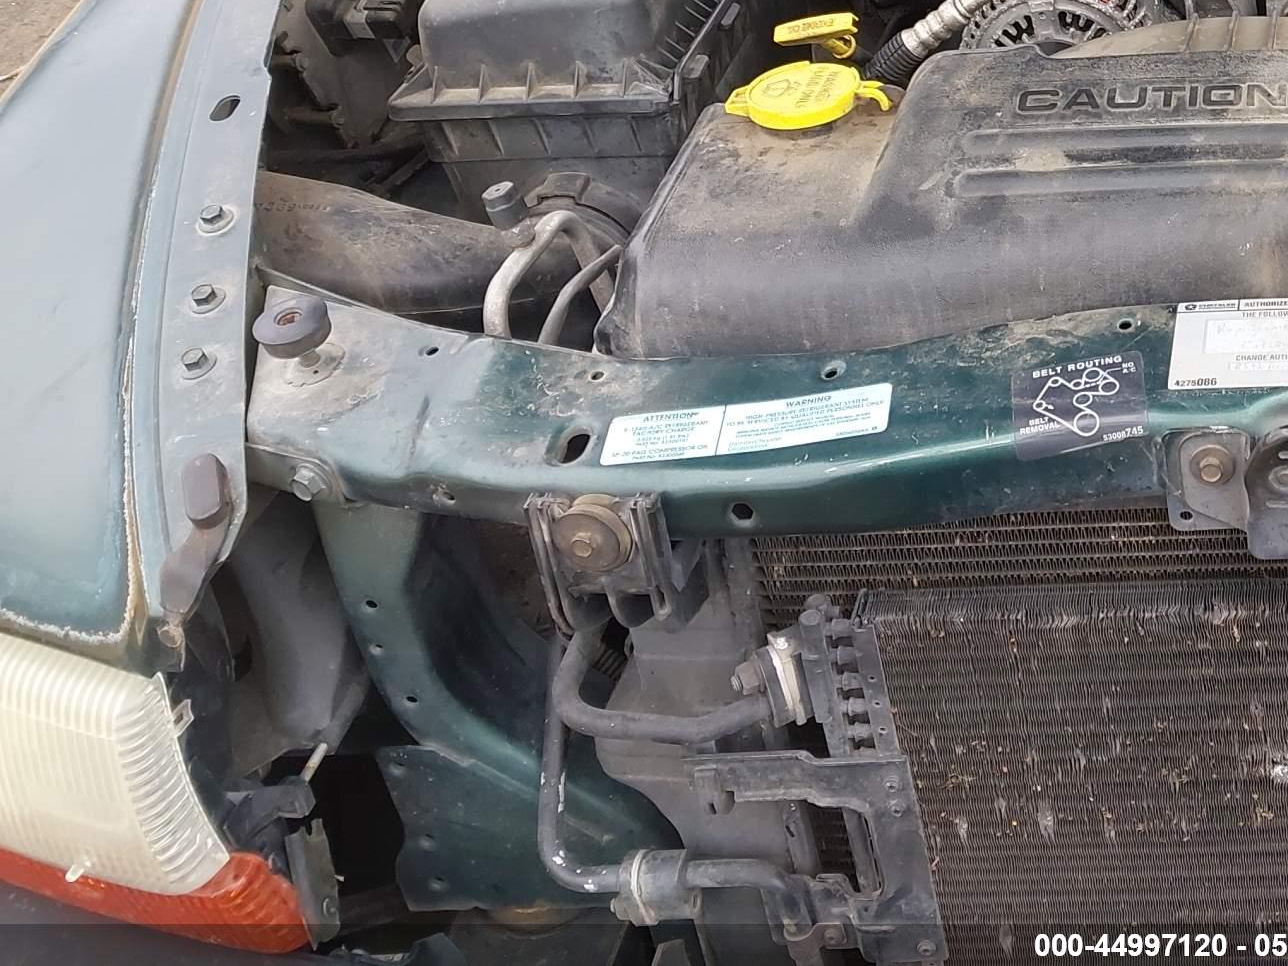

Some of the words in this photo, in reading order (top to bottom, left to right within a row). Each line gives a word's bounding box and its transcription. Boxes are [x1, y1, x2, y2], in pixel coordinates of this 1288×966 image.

[1032, 366, 1062, 379] BELT
[1067, 355, 1122, 371] ROUTING
[1174, 378, 1218, 387] 4275086
[785, 395, 832, 408] WARNING
[643, 412, 696, 423] ATTENTION
[1028, 416, 1049, 426] BELT
[1020, 420, 1061, 435] REMOVAL
[1102, 425, 1144, 442] 53008745
